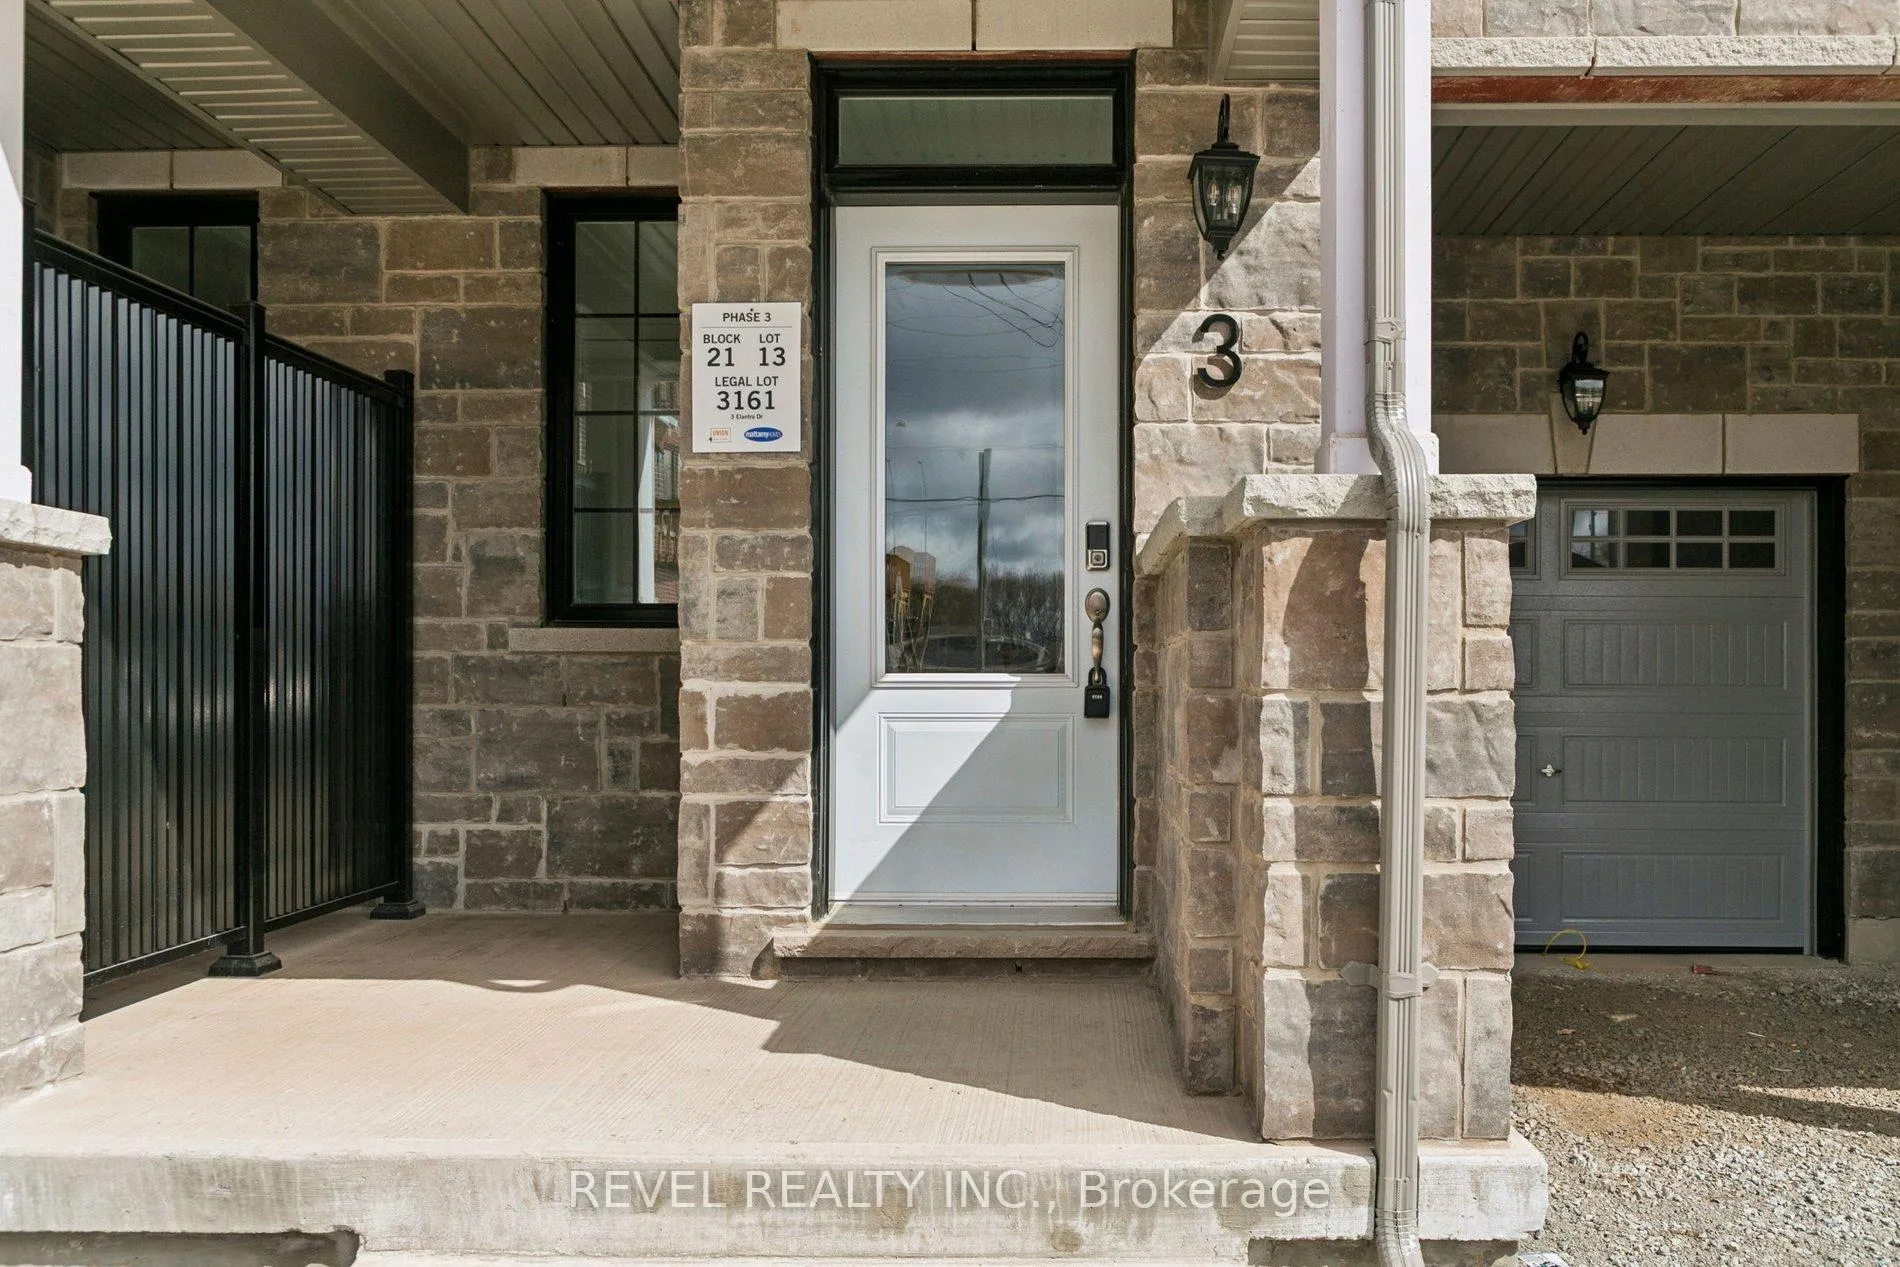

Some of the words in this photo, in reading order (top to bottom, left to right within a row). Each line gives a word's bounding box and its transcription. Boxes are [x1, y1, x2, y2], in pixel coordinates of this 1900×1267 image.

[722, 312, 761, 323] PHASE
[764, 312, 772, 323] 3
[703, 333, 741, 344] BLOCK
[759, 333, 781, 344] LOT
[707, 346, 735, 367] 21
[758, 346, 786, 367] 13
[1191, 313, 1242, 388] 3
[714, 376, 753, 387] LEGAL
[756, 375, 779, 387] LOT
[716, 389, 776, 410] 3161
